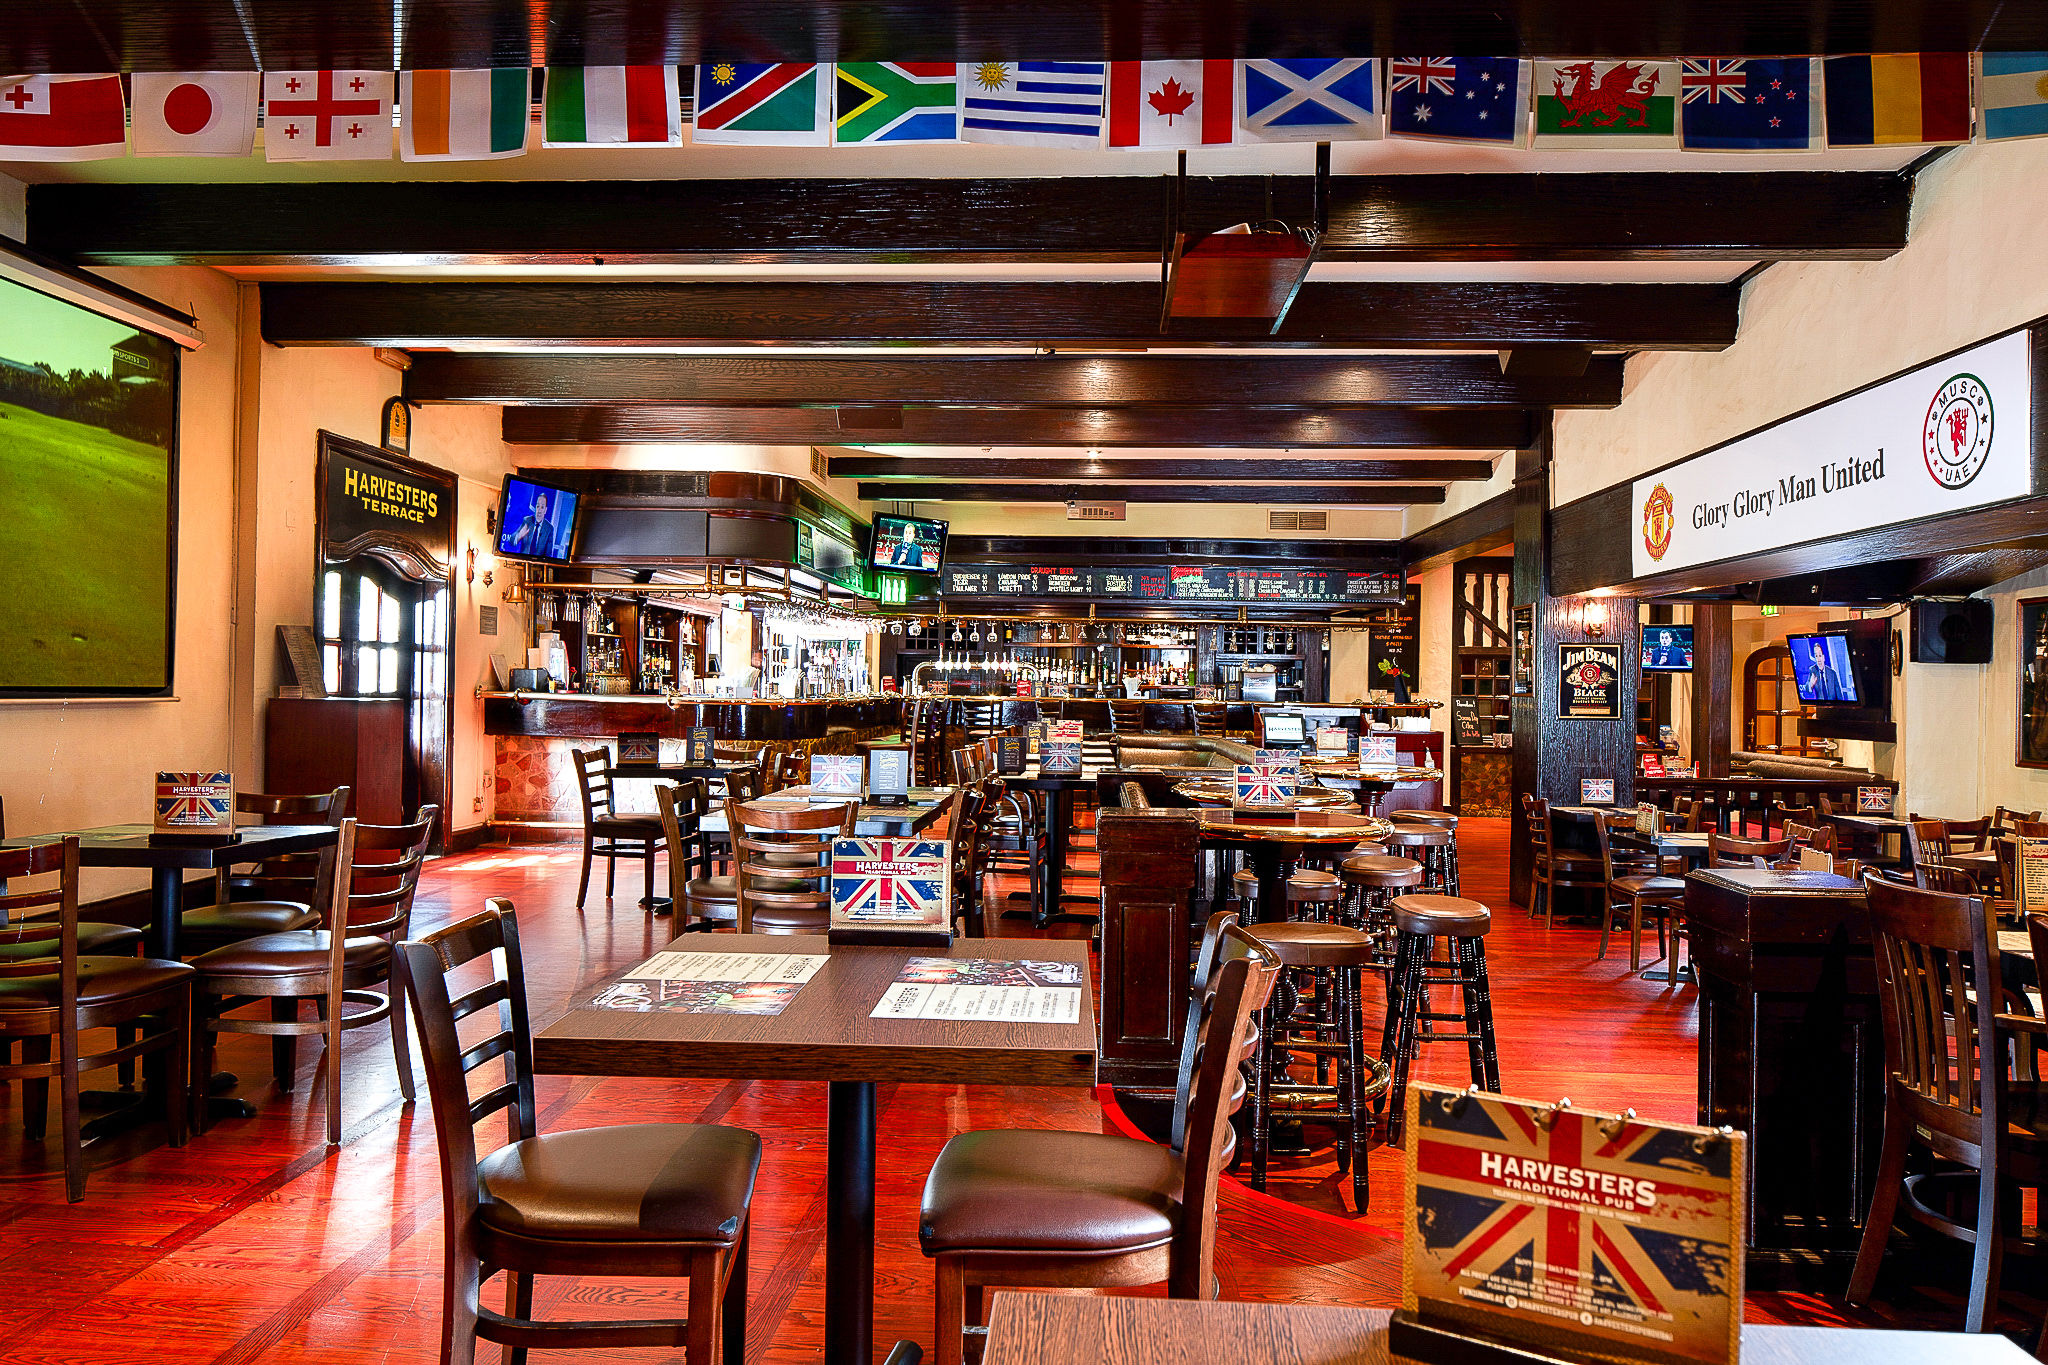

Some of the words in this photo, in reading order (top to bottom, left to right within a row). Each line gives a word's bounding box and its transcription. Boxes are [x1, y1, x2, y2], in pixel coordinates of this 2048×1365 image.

[1938, 380, 1978, 408] MUSC
[1945, 463, 1970, 482] UAE
[344, 467, 438, 518] HARVESTERS
[1692, 502, 1729, 530] Glory
[1733, 489, 1775, 517] Glory
[1778, 474, 1816, 506] Man
[1820, 447, 1886, 493] United
[361, 496, 425, 524] TERRACE
[1649, 541, 1668, 556] UNITED
[997, 572, 1016, 580] LONDON
[1018, 573, 1032, 581] PRIDE
[1030, 566, 1057, 575] DRAUGHT
[1059, 567, 1074, 575] BEER
[998, 584, 1023, 592] MORETTI
[1562, 651, 1584, 670] JIM
[1586, 647, 1617, 671] BEAM
[1573, 687, 1607, 698] BLACK
[173, 786, 214, 794] HARVESTERS
[855, 861, 918, 873] HARVESTERS
[1480, 1151, 1657, 1207] HARVESTERS
[1503, 1176, 1600, 1205] TRADITIONAL
[1604, 1196, 1635, 1211] PUB
